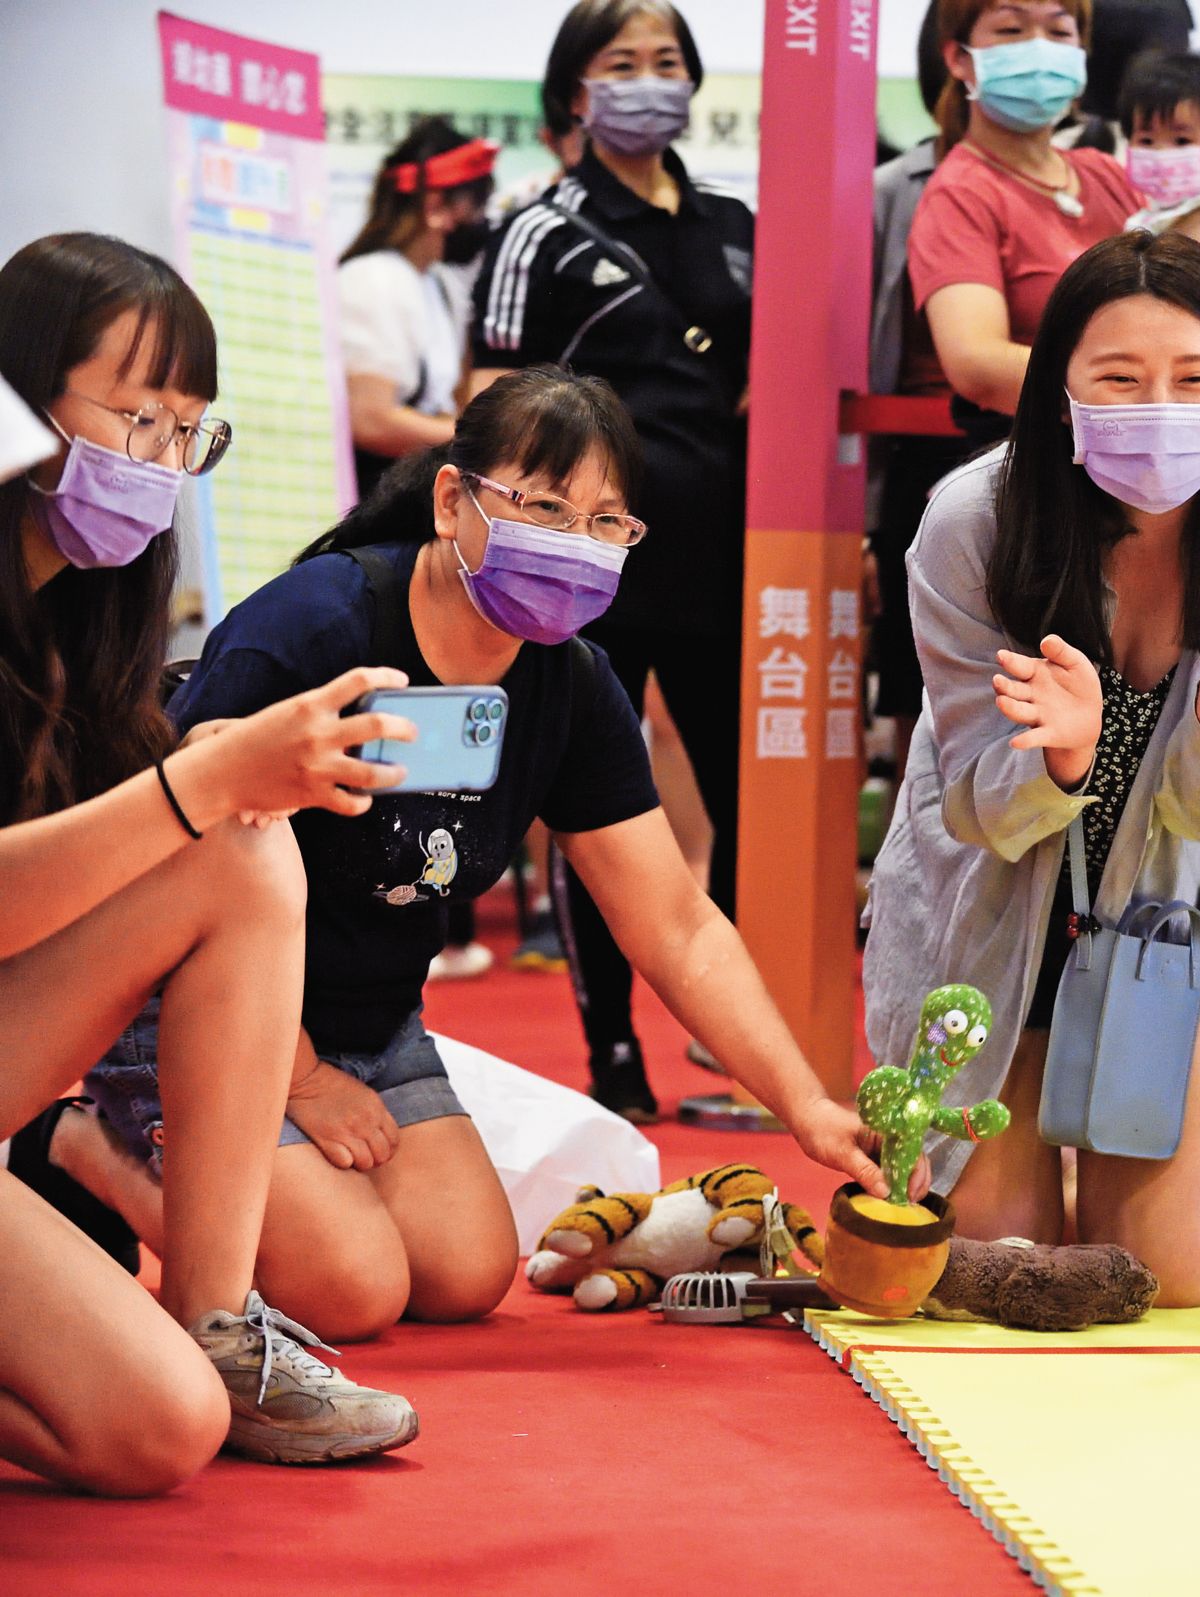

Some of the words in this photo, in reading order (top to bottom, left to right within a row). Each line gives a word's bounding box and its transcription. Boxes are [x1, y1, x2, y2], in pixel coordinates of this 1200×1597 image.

[756, 585, 810, 758] 舞台區
[826, 588, 860, 759] 舞台區
